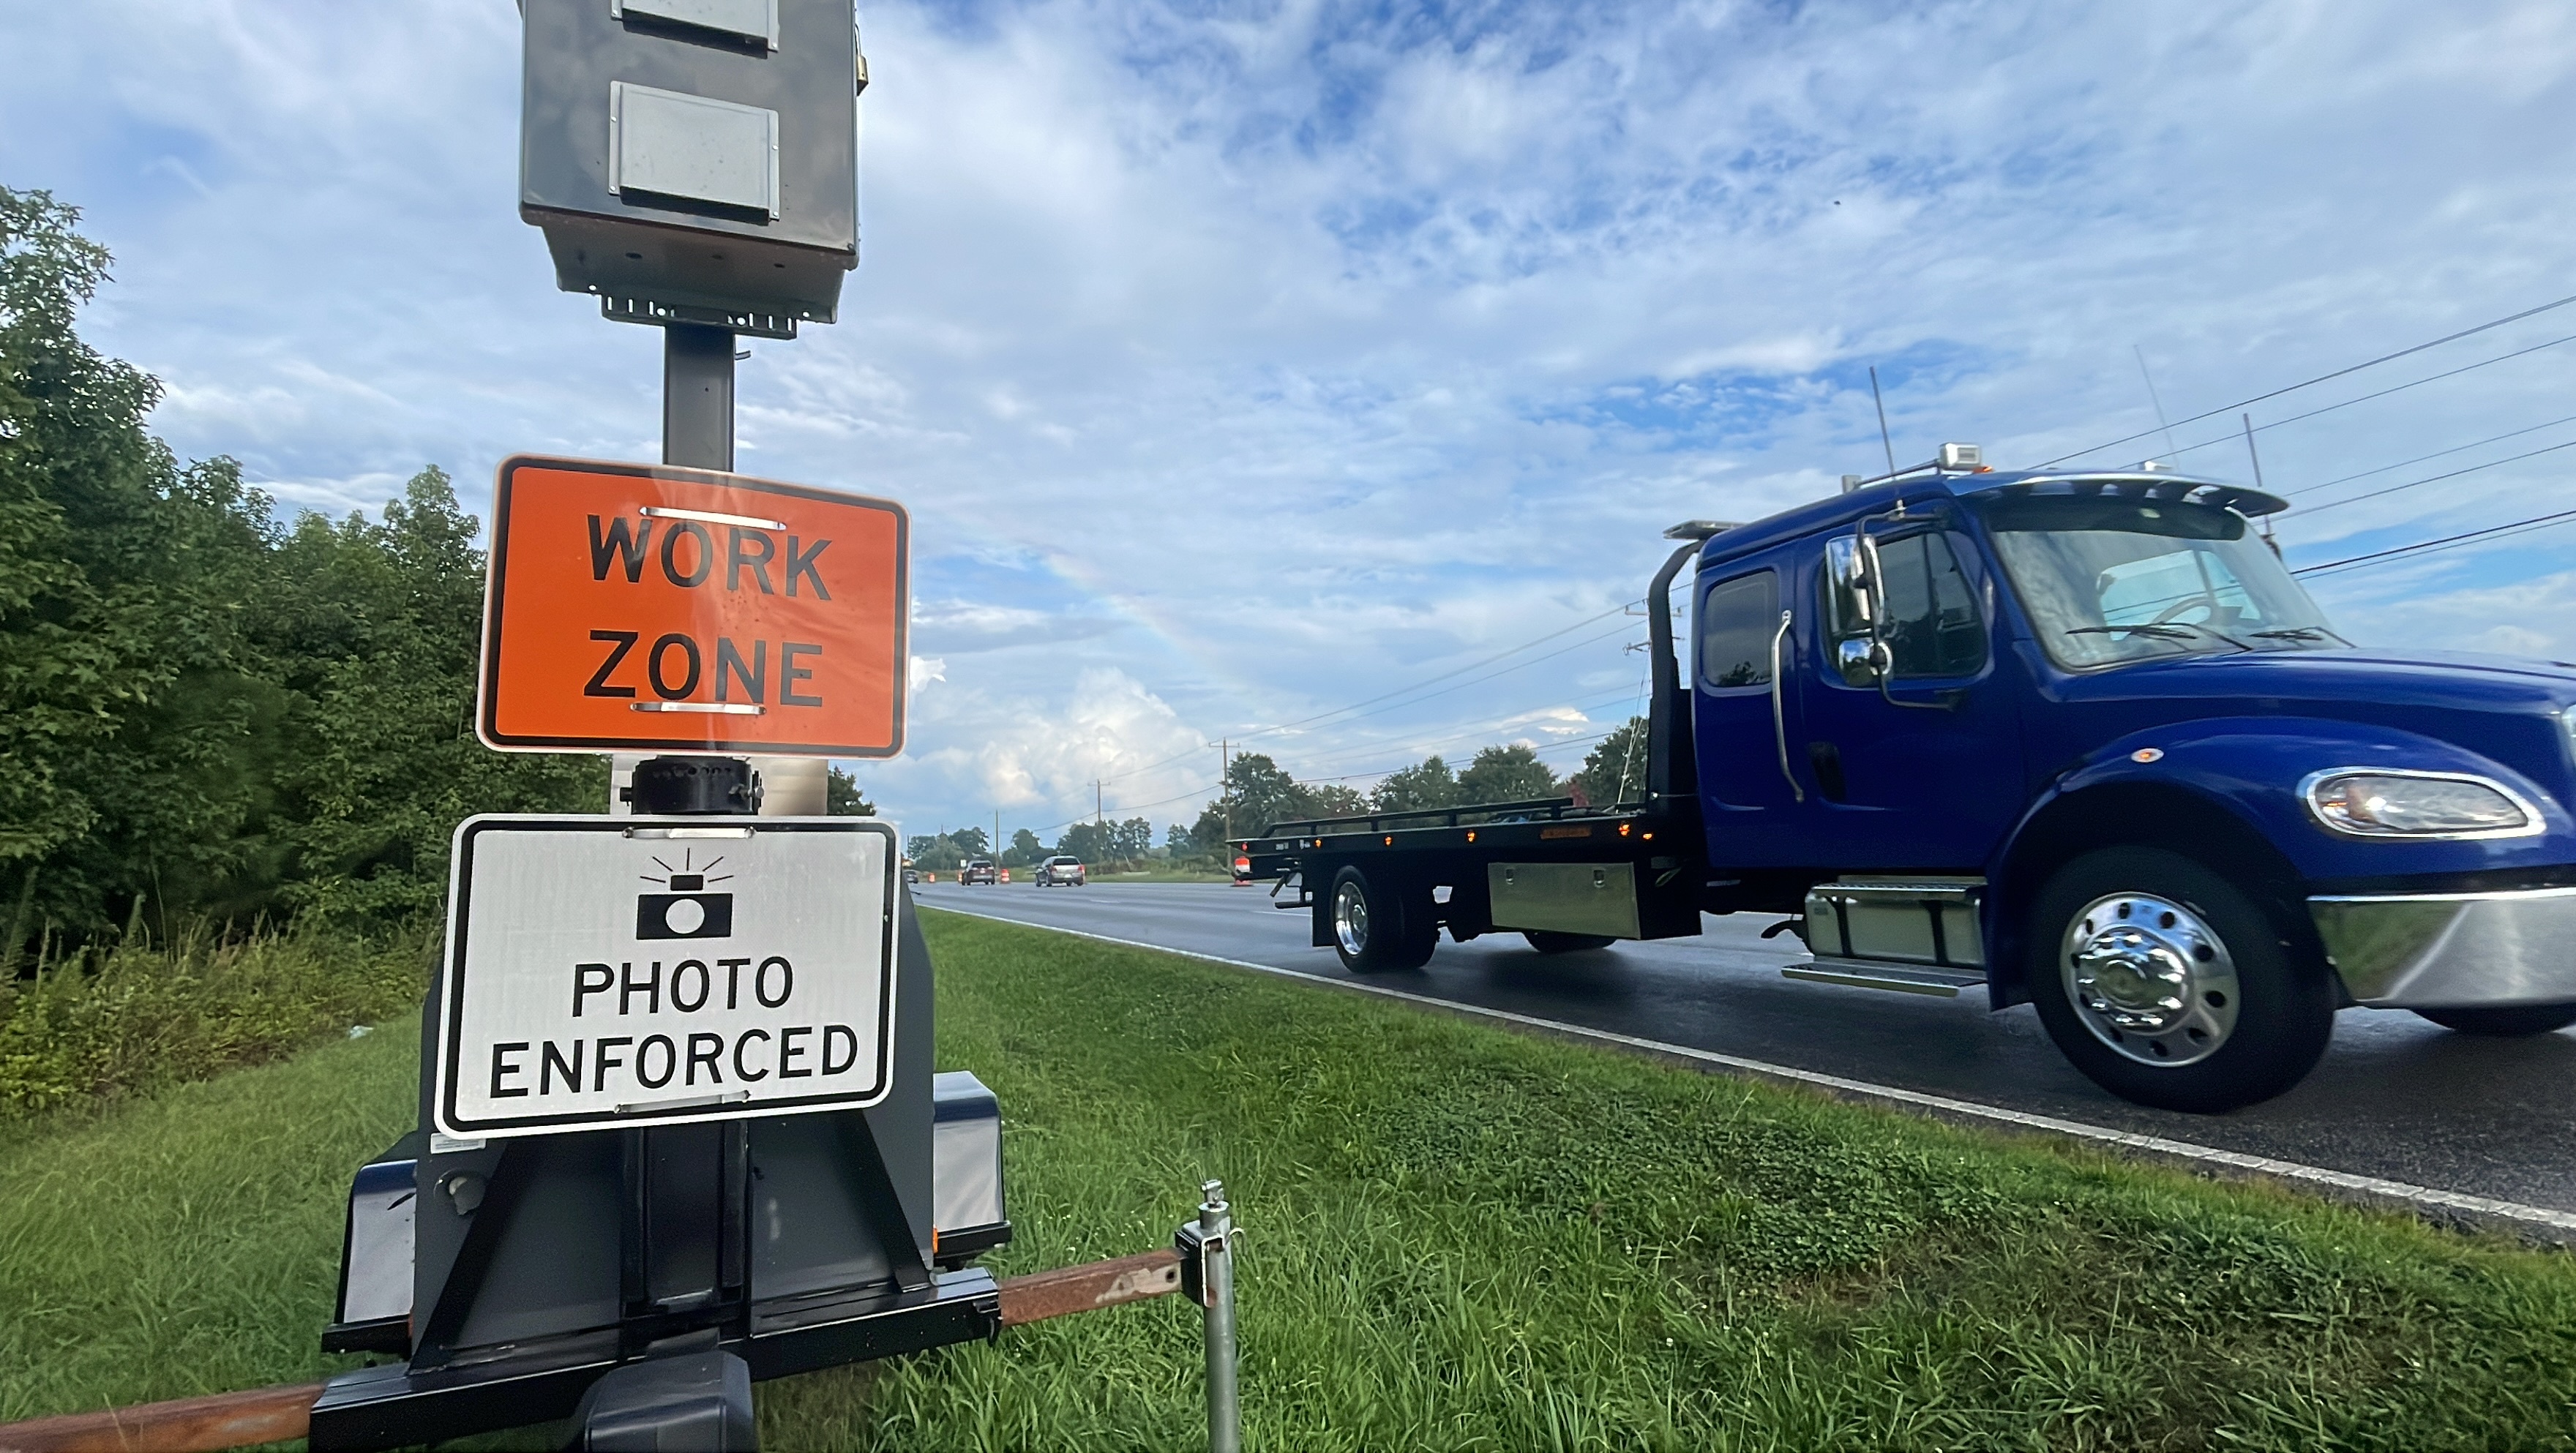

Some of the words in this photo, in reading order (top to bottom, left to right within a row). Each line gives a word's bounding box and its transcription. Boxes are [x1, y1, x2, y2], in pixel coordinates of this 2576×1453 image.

[587, 514, 833, 601] WORK
[583, 629, 823, 707] ZONE
[572, 956, 793, 1017] PHOTO
[490, 1024, 858, 1098] ENFORCED
